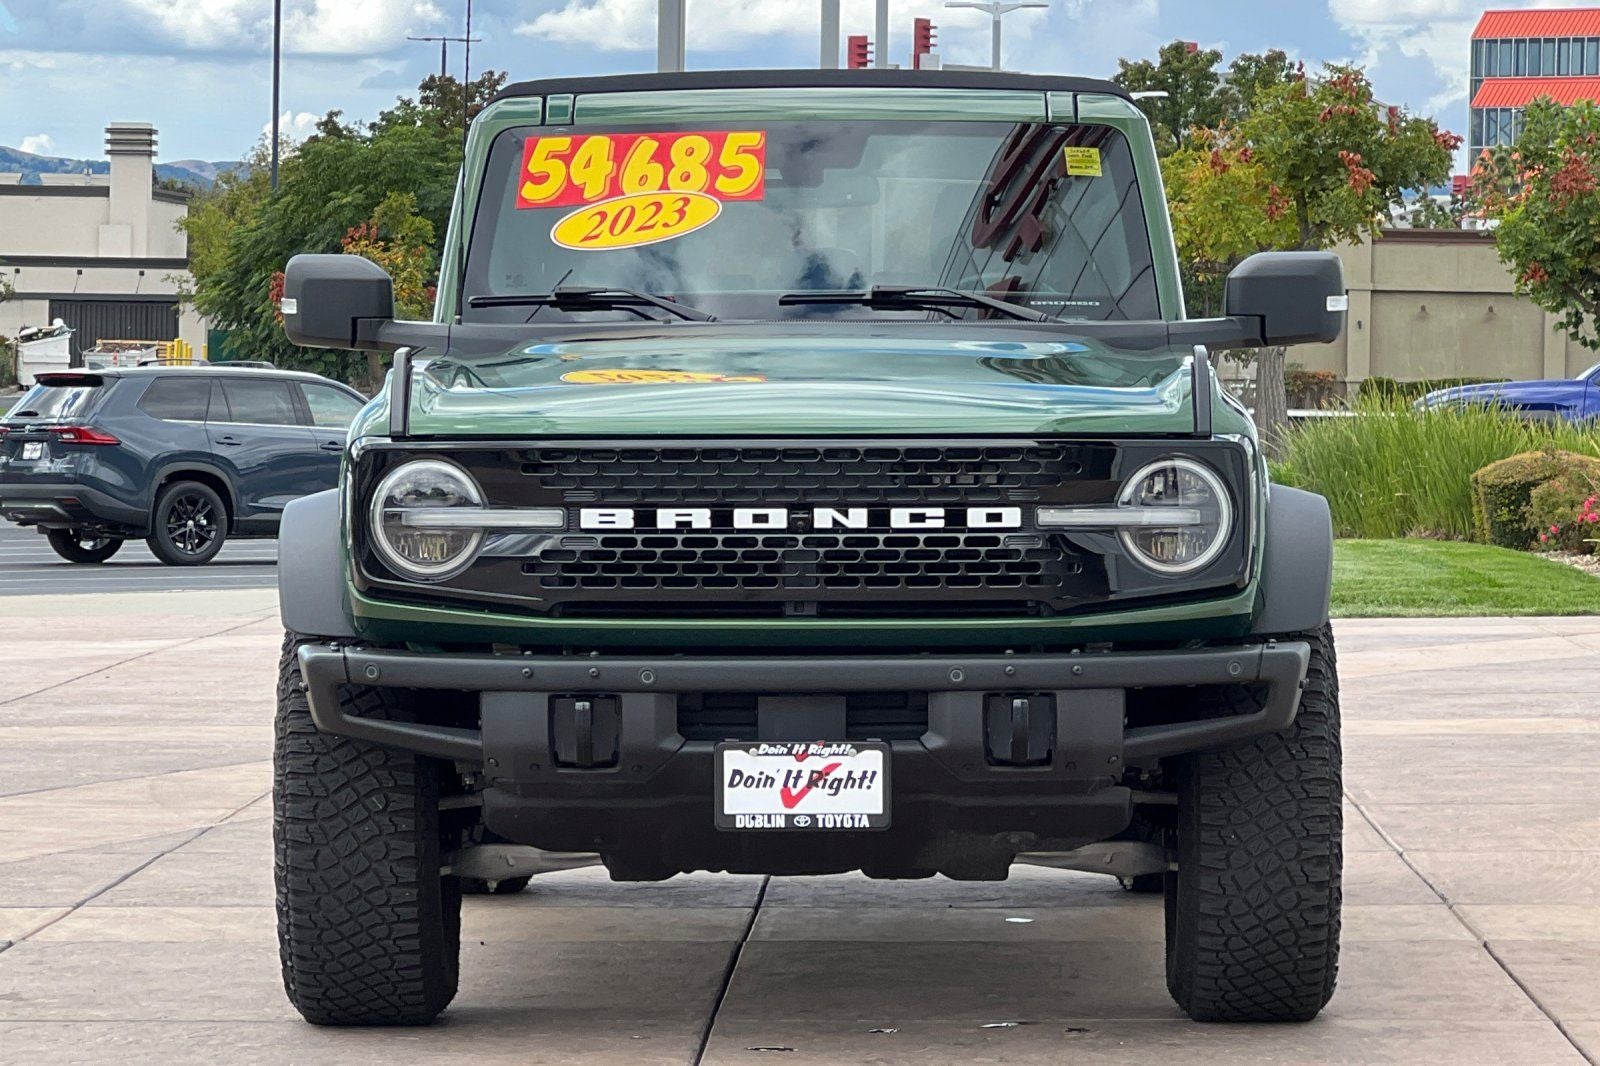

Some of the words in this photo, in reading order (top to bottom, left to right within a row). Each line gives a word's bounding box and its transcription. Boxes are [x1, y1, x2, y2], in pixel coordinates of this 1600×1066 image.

[520, 132, 765, 202] 54685
[579, 197, 691, 242] 2023
[580, 507, 1021, 529] BRONCO
[758, 744, 791, 755] Doin'
[792, 743, 806, 755] It
[808, 744, 851, 758] Right!
[728, 768, 780, 788] Doin'
[783, 769, 803, 788] It
[806, 769, 878, 797] Right!
[735, 813, 786, 828] DUBLIN
[816, 813, 870, 828] TOYOTA
